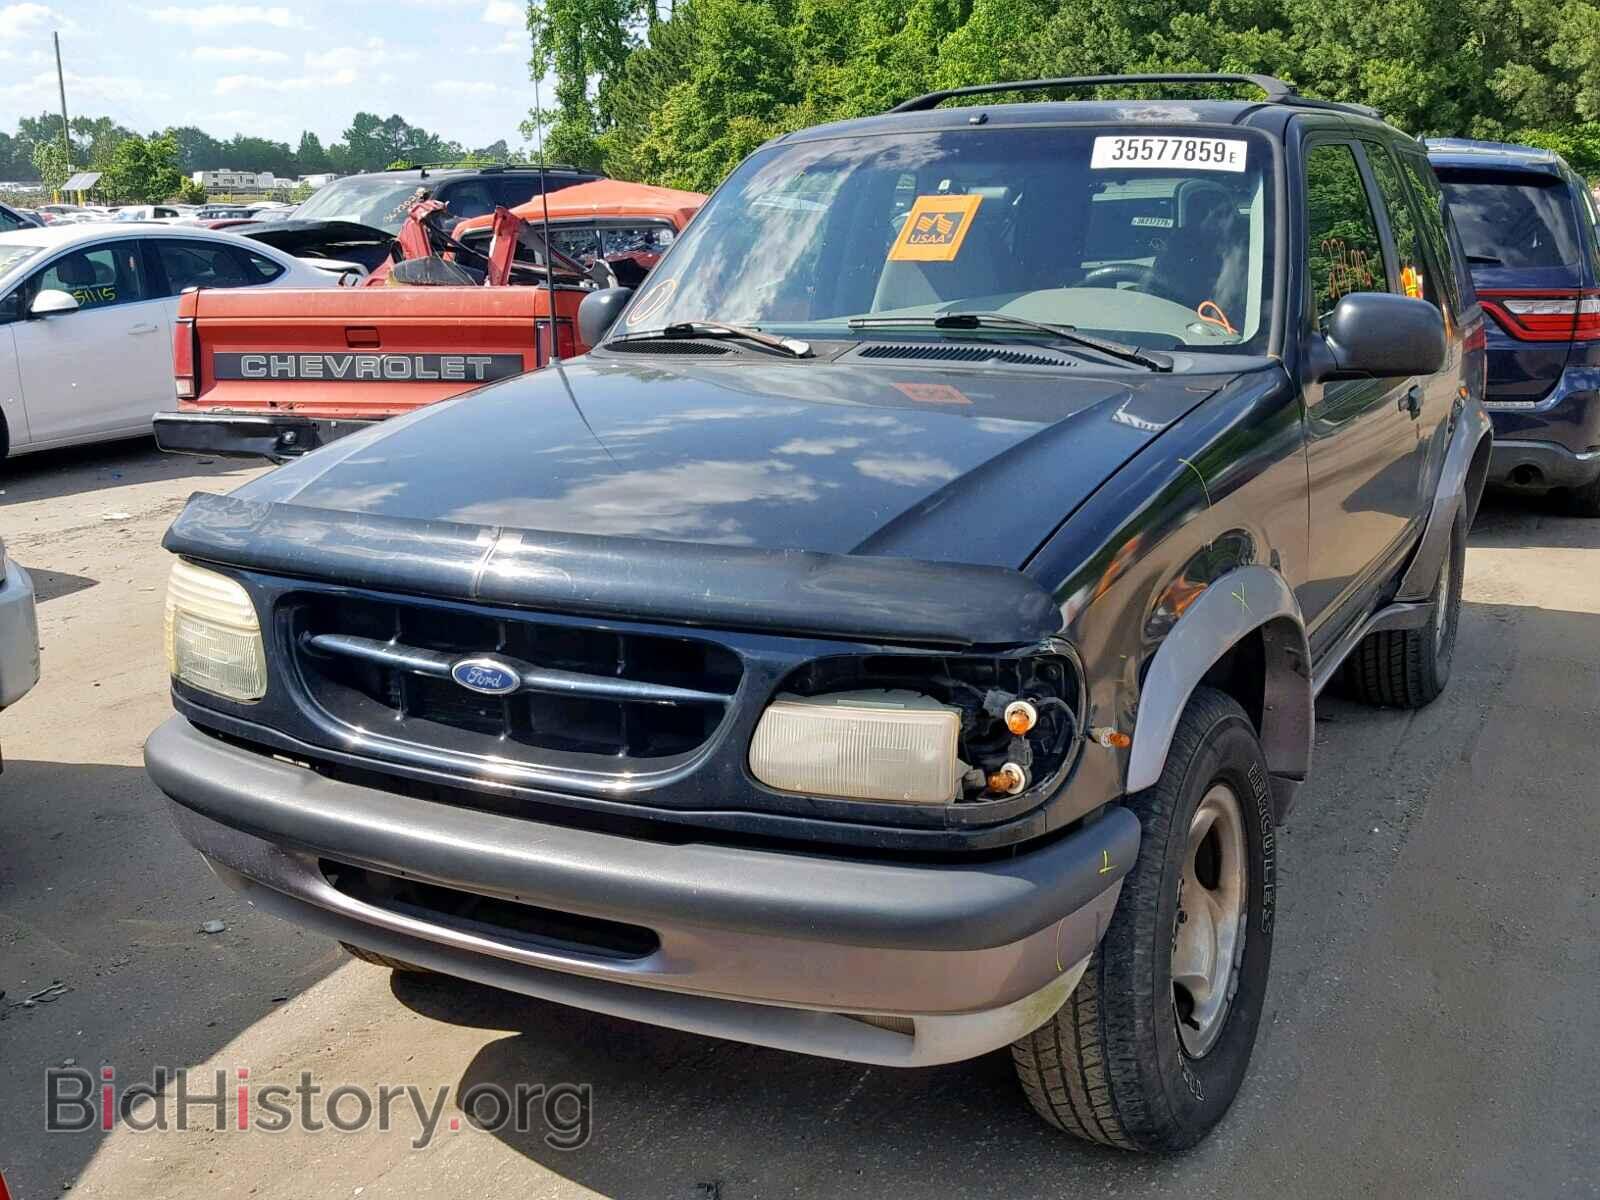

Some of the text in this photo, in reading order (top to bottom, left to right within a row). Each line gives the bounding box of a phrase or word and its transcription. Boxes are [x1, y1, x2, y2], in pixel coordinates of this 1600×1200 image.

[1112, 138, 1240, 164] 35577859 E
[909, 233, 945, 244] USAA
[240, 355, 492, 380] CHEVROLET
[467, 666, 503, 688] Ford
[1247, 760, 1276, 935] HERCULES
